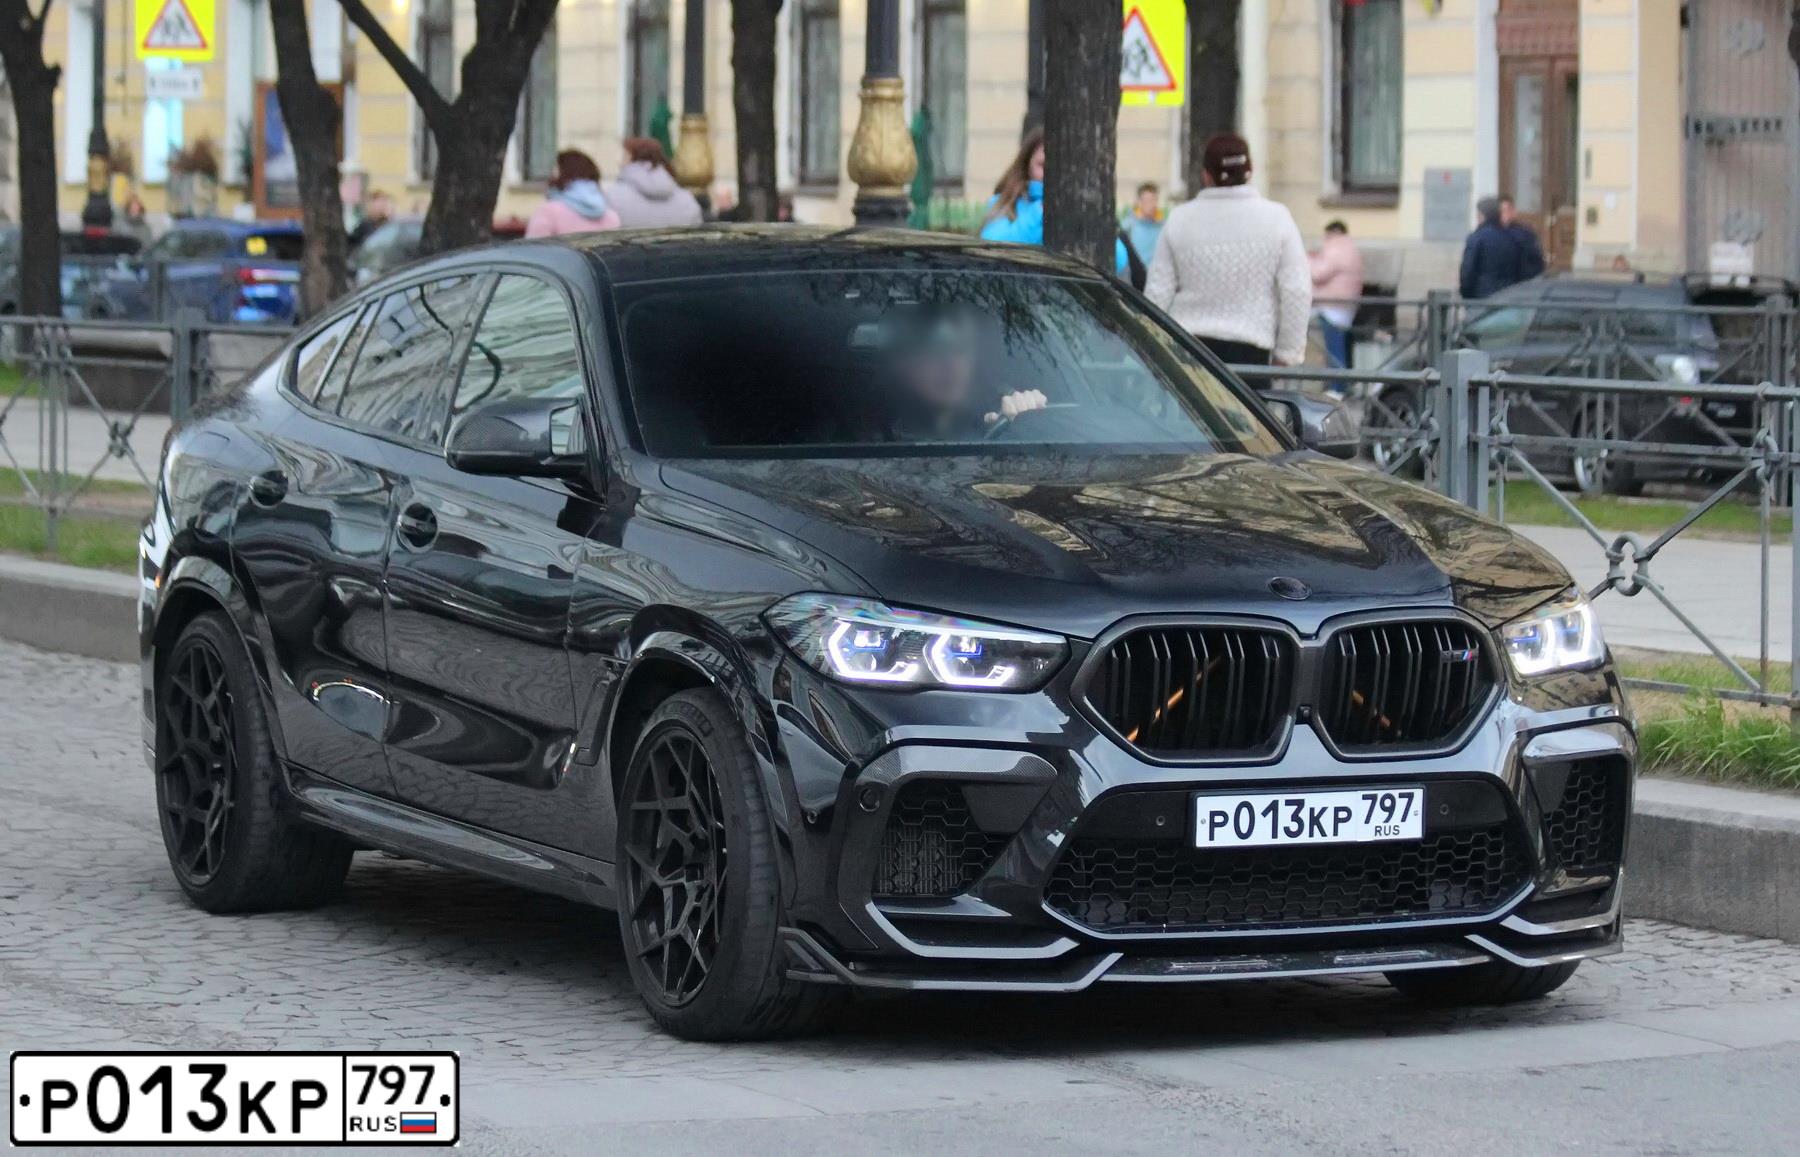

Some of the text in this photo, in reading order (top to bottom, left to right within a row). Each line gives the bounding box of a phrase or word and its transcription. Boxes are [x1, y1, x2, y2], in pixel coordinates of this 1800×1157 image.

[1208, 791, 1415, 842] P013KP 797
[1374, 824, 1401, 837] RUS
